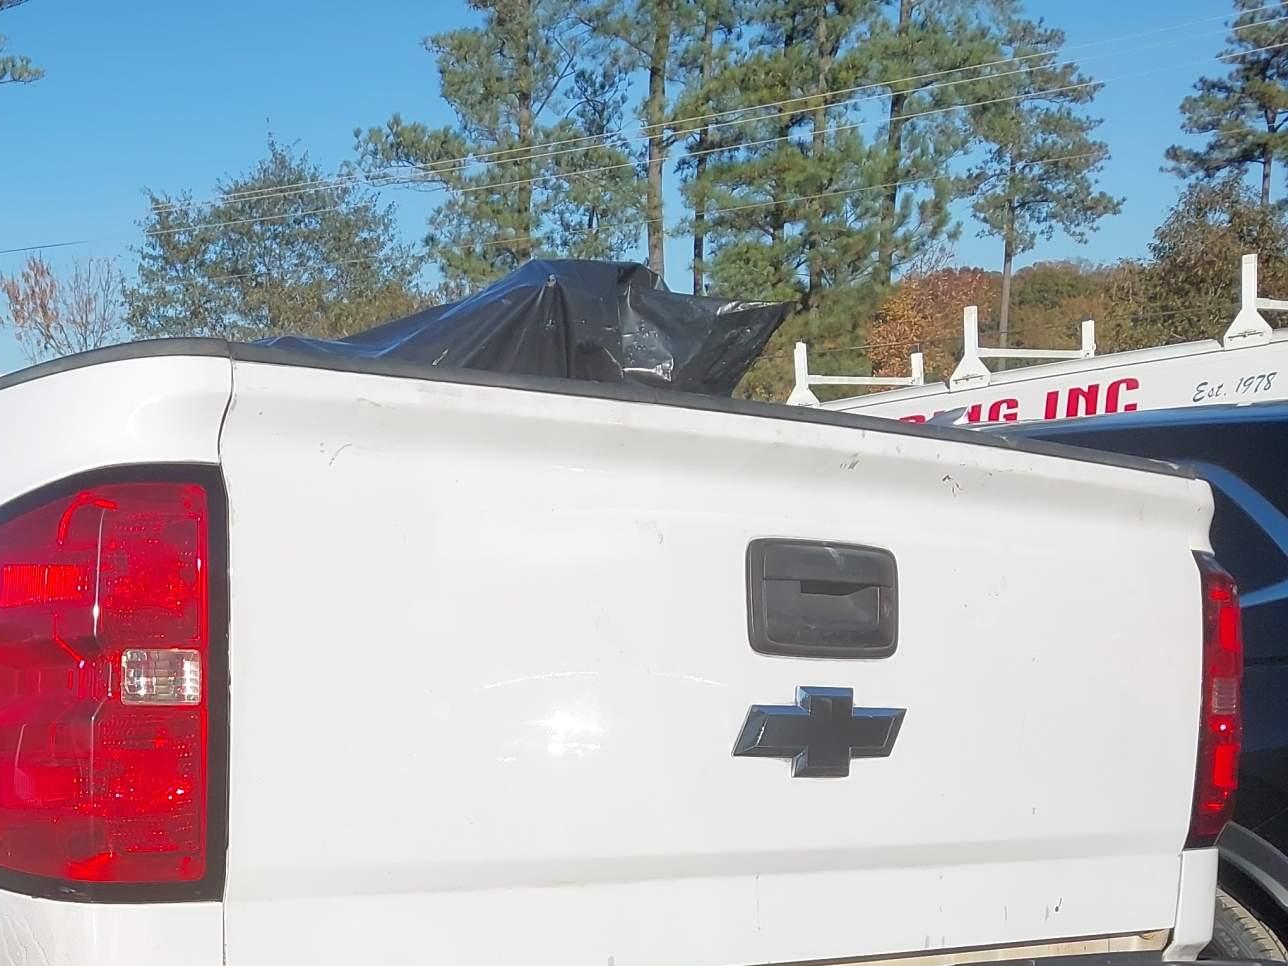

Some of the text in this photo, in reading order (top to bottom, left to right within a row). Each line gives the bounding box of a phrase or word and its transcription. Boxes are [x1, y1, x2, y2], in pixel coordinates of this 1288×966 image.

[1044, 378, 1140, 421] INC
[1192, 371, 1278, 403] Est. 1978
